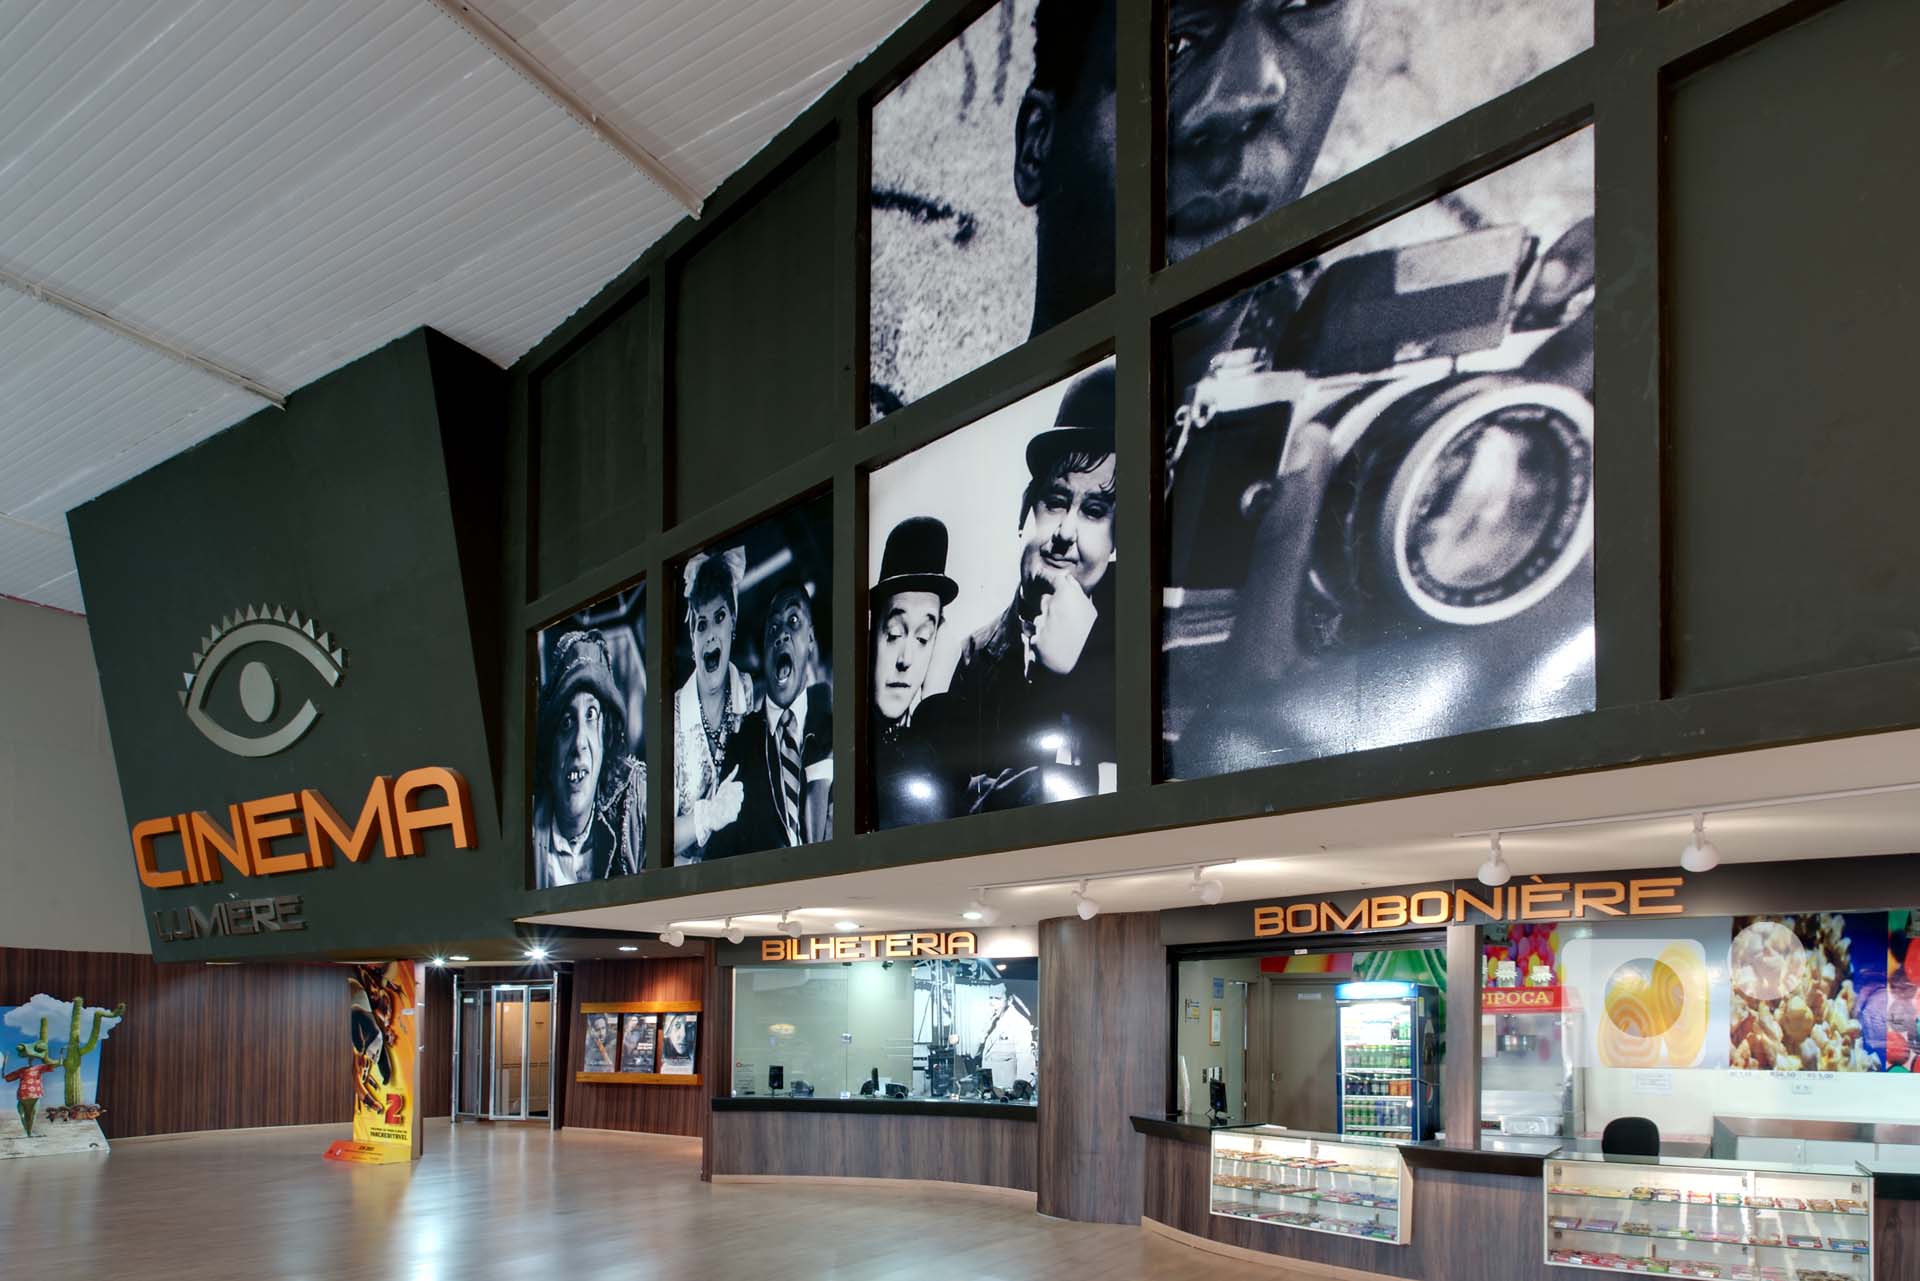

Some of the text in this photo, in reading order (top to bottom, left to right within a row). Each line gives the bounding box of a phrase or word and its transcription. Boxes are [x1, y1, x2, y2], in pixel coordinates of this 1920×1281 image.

[132, 766, 474, 889] CINEMA
[153, 893, 308, 942] LUMIÈRE
[1254, 875, 1684, 937] BOMBONIÈRE
[761, 931, 977, 961] BILHETERIA
[385, 1093, 404, 1124] 2
